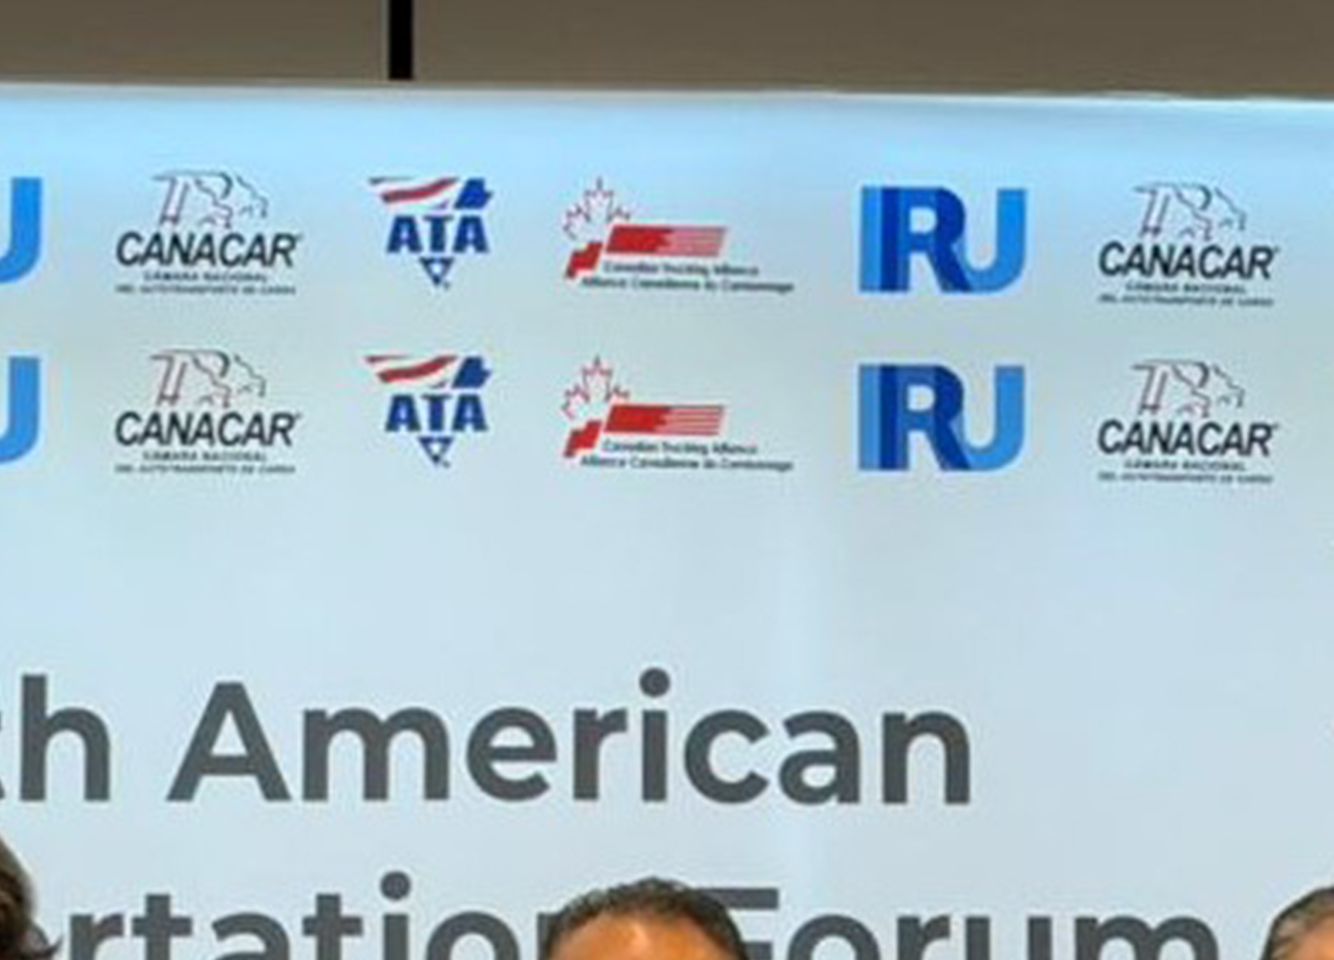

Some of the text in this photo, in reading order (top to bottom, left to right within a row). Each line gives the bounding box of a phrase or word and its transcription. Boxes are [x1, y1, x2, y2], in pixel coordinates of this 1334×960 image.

[115, 231, 296, 268] CANACAR
[387, 215, 487, 253] ATA
[859, 186, 1027, 293] IRU
[1098, 241, 1274, 280] CANACAR
[114, 411, 295, 447] CANACAR
[386, 395, 486, 431] ATA
[858, 364, 1025, 472] IRU
[1097, 419, 1272, 457] CANACAR
[166, 667, 973, 804] American
